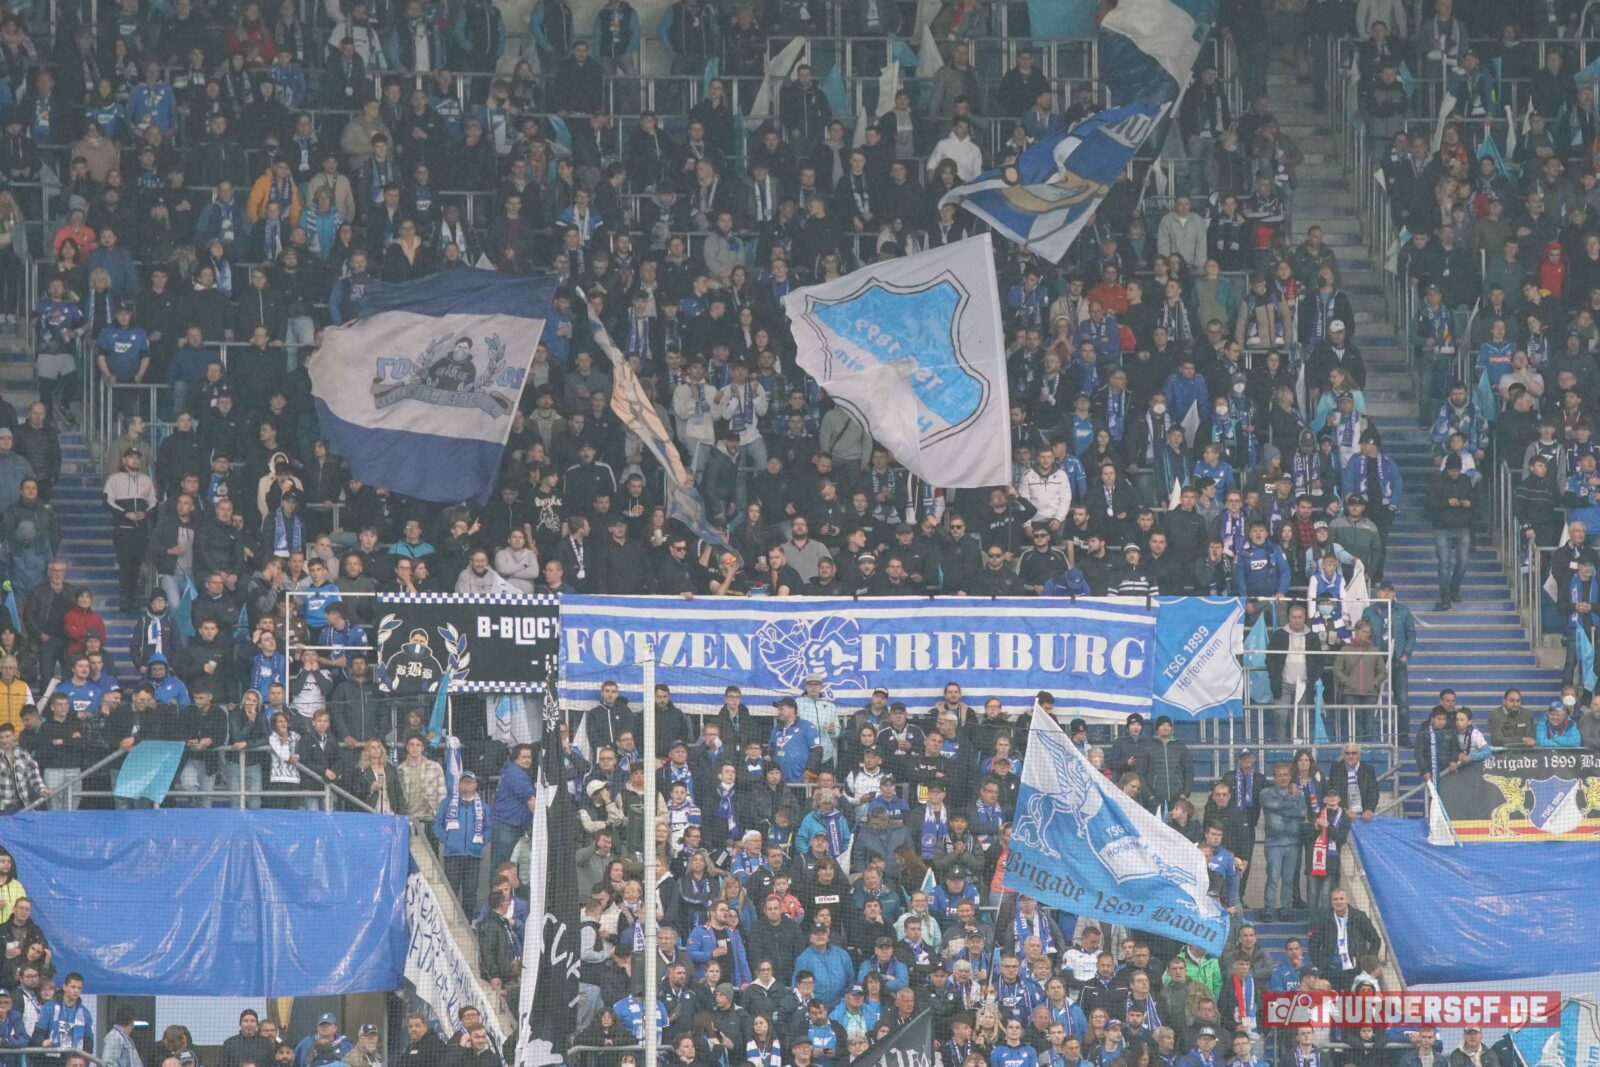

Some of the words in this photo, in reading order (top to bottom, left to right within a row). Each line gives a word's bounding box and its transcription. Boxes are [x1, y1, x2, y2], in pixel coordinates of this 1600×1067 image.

[1251, 561, 1266, 569] SAP
[564, 628, 756, 671] FOTZEN
[858, 632, 1146, 680] FREIBURG
[1162, 654, 1188, 680] TSG
[1183, 626, 1209, 655] 1899
[1175, 638, 1224, 692] Hoffenheim
[1482, 755, 1538, 772] Brigade
[1544, 755, 1576, 768] 1899
[1006, 850, 1086, 902] Brigade
[1094, 887, 1144, 916] 1899
[1152, 905, 1218, 944] Baden
